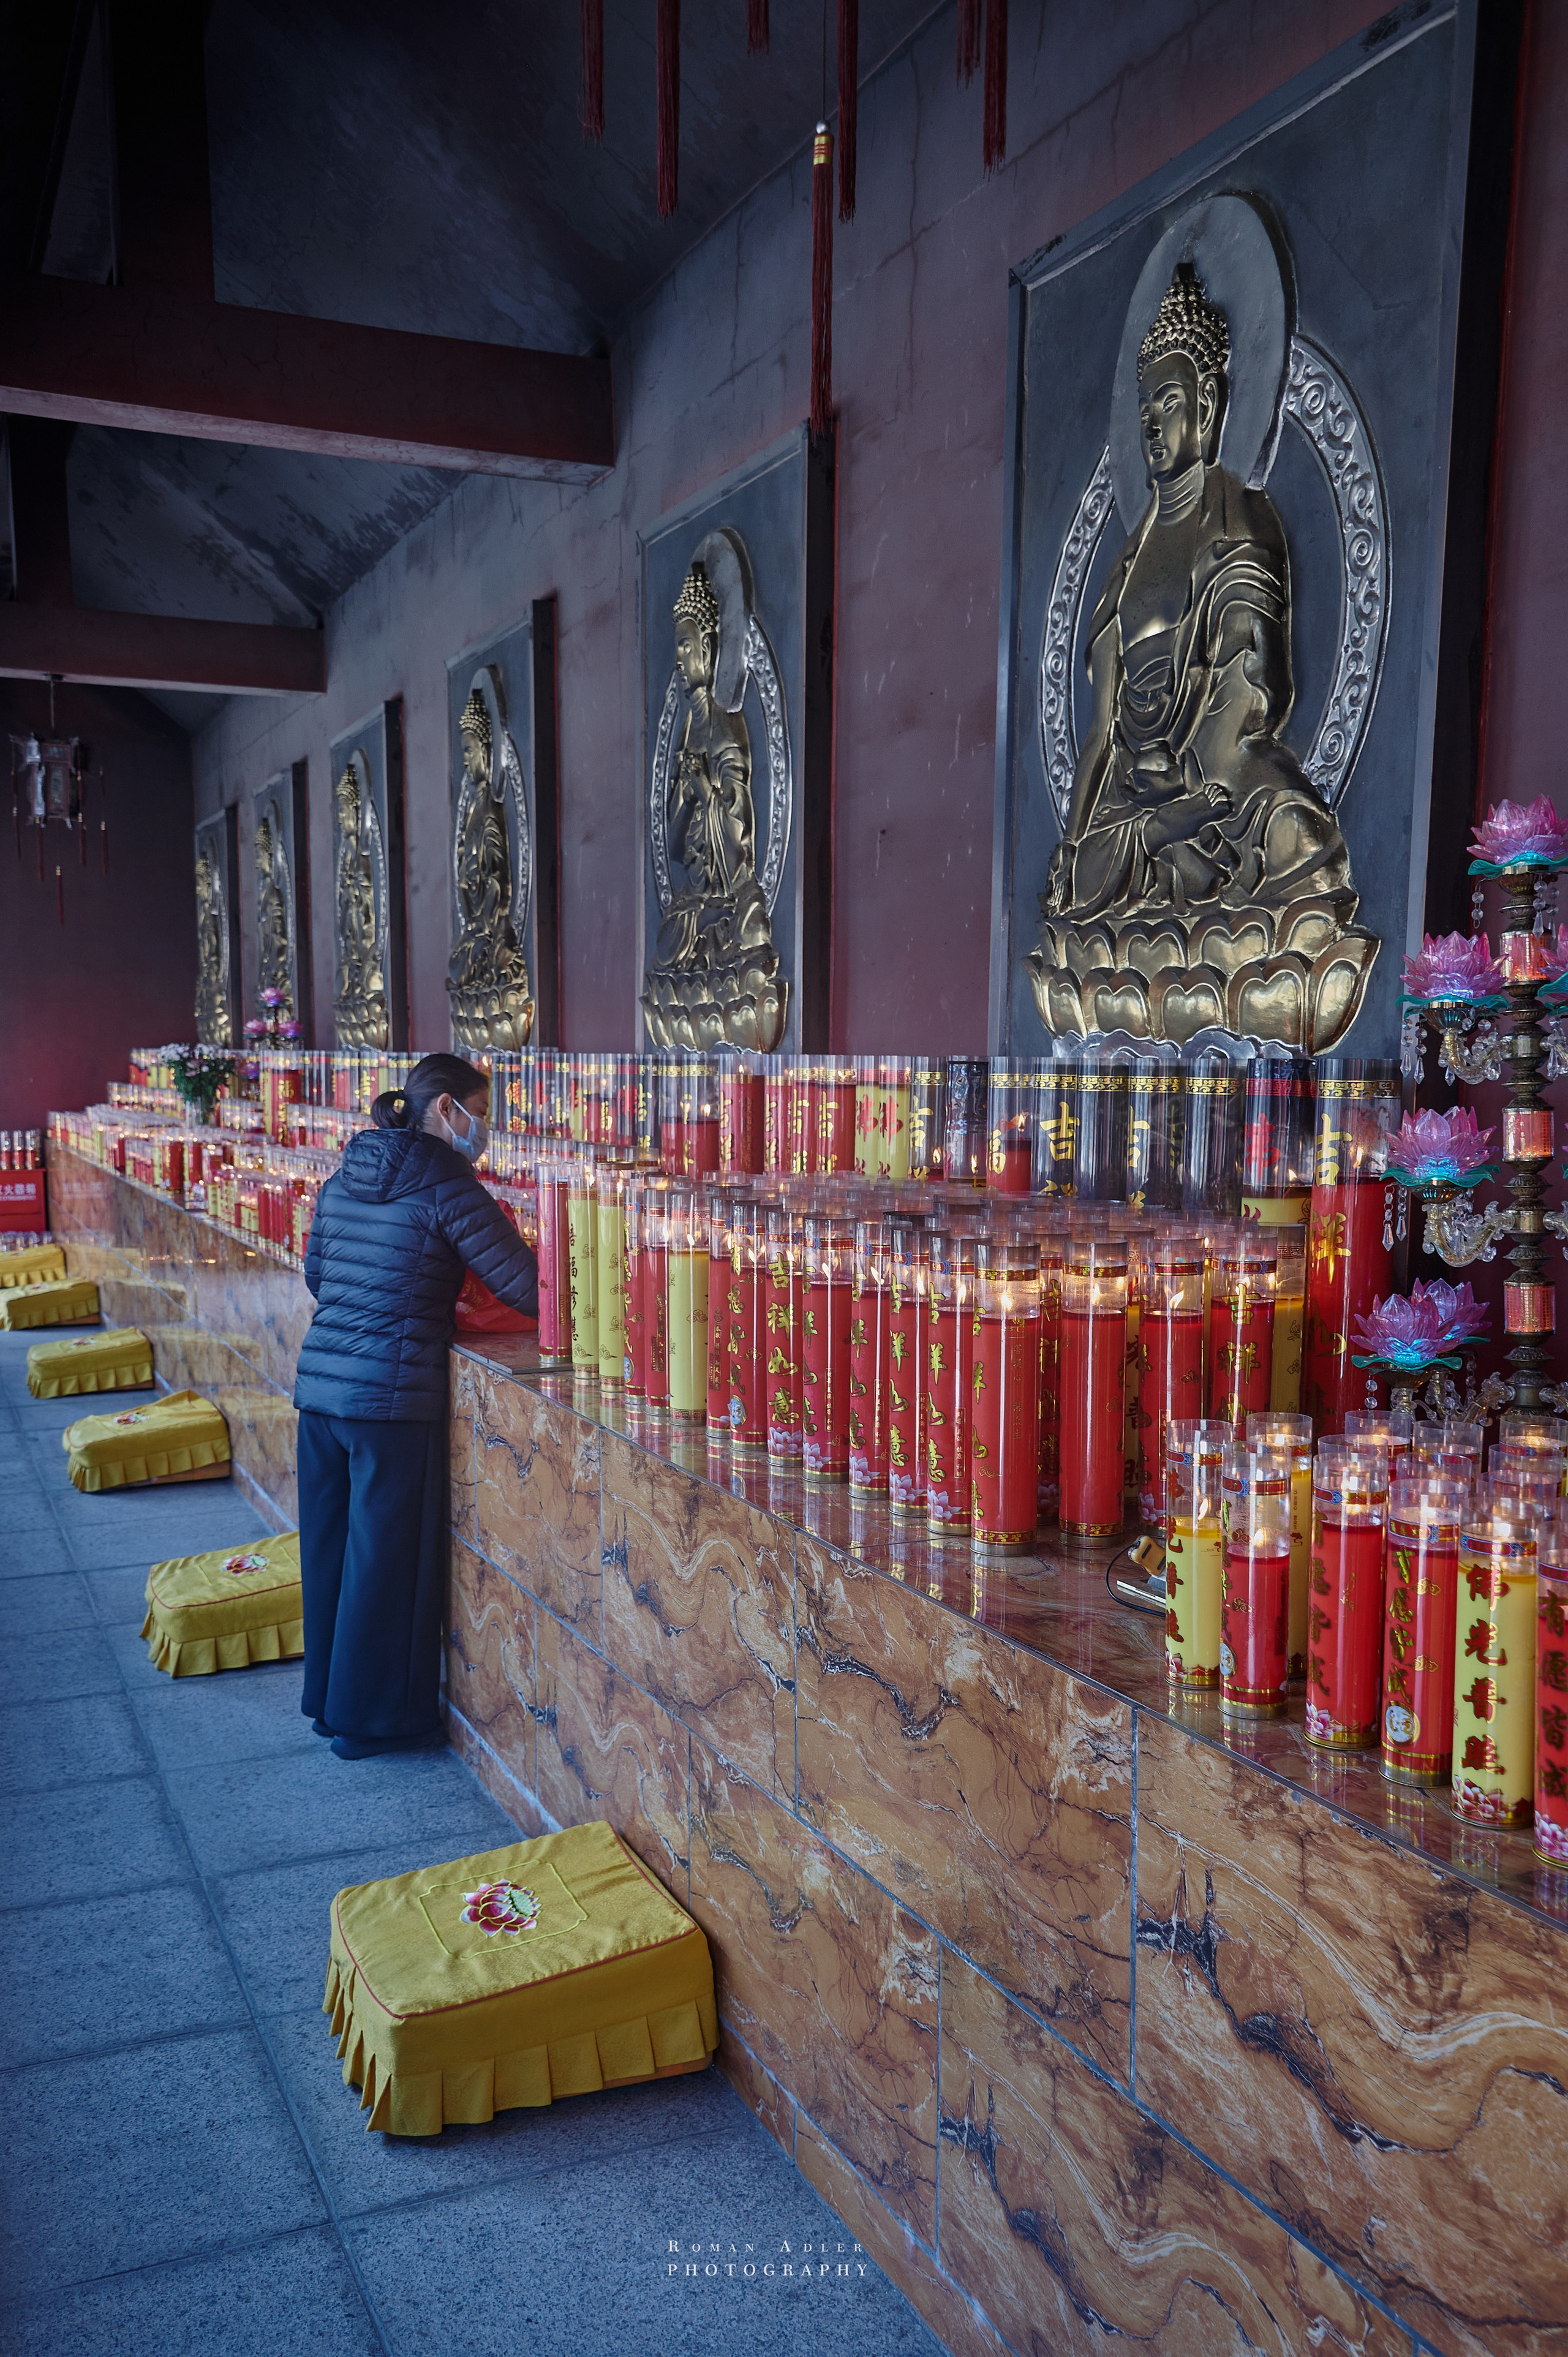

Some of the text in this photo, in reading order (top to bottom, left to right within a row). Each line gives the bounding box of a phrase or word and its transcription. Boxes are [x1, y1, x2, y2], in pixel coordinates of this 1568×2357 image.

[1039, 1101, 1080, 1161] 吉
[767, 1251, 799, 1426] 吉祥如意
[1460, 1561, 1510, 1775] 佛光普照
